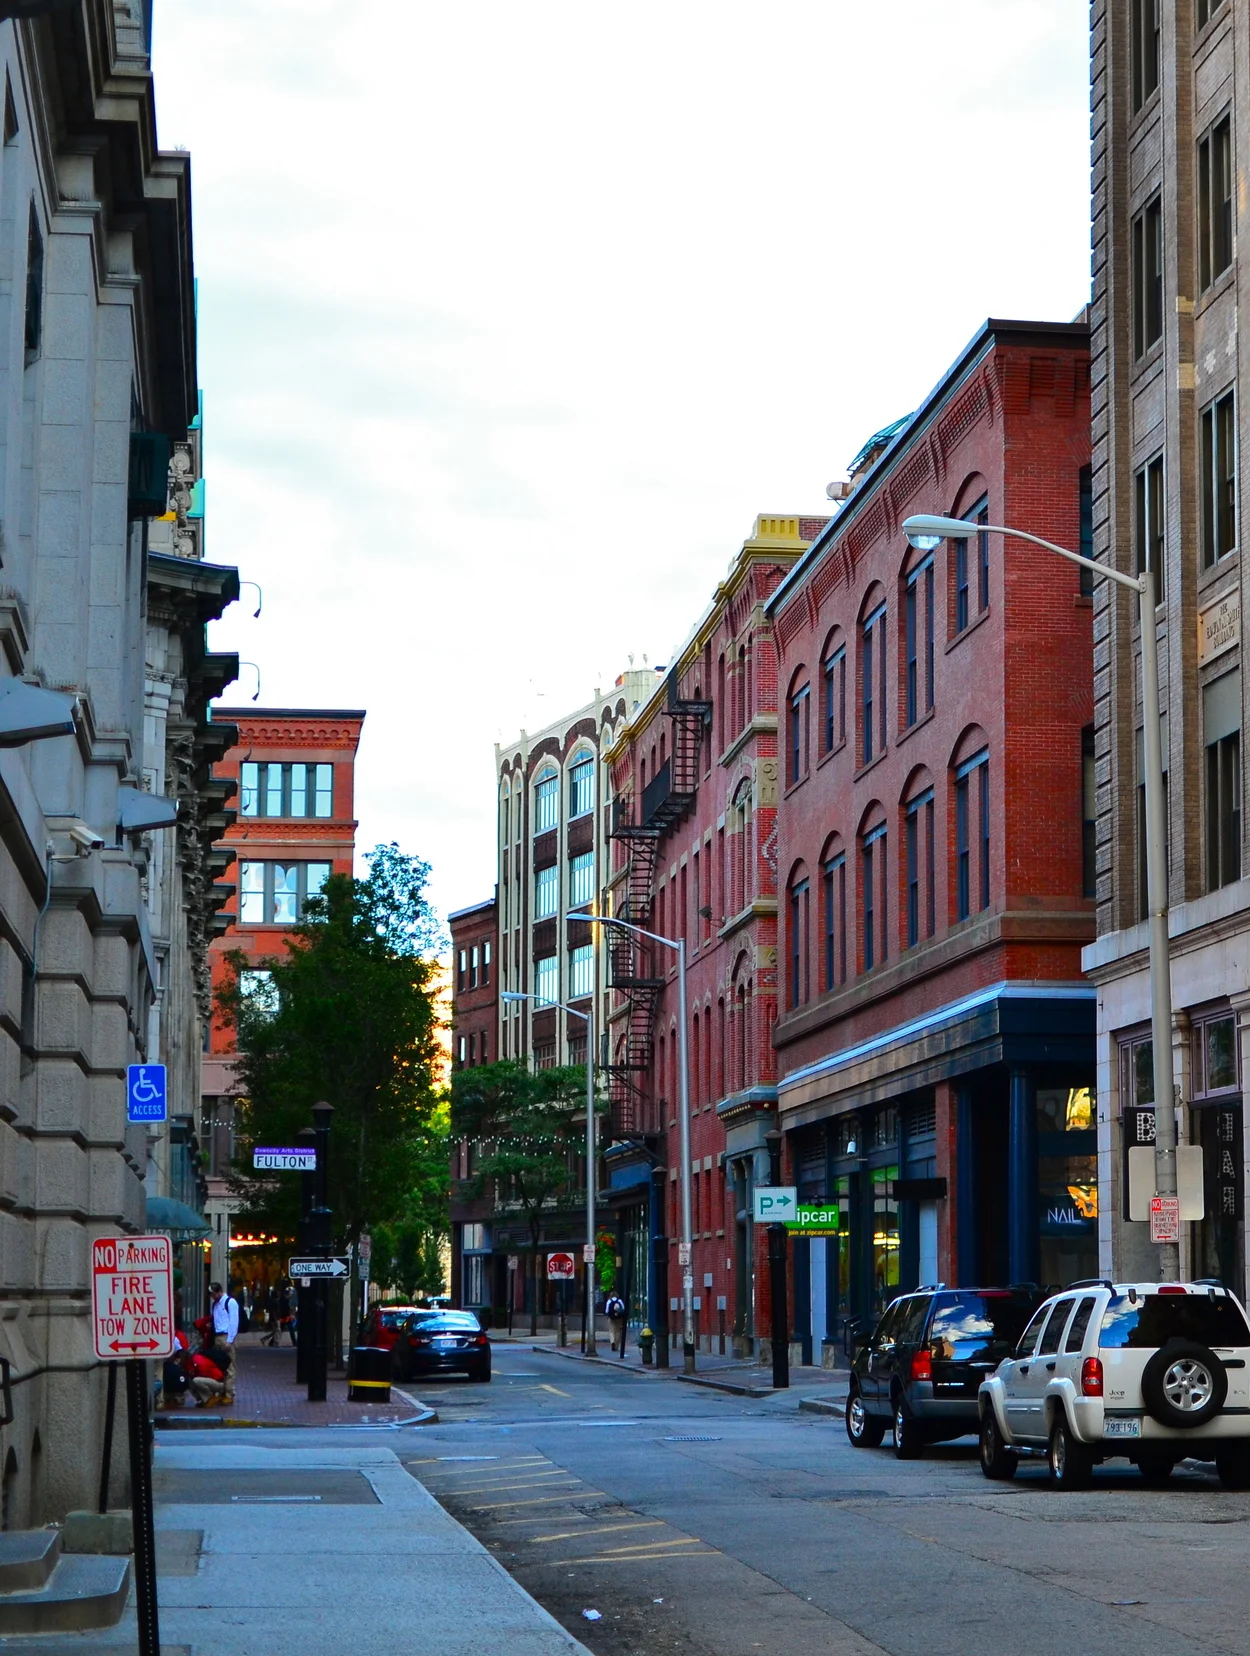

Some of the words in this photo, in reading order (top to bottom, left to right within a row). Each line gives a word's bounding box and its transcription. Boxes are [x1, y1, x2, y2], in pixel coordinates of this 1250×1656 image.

[133, 1105, 162, 1115] ACCESS
[256, 1155, 306, 1168] FULTON
[1152, 1200, 1161, 1209] NO
[796, 1208, 836, 1226] ipcar
[1047, 1207, 1082, 1224] NAIL
[95, 1246, 115, 1268] NO
[118, 1247, 166, 1264] PARKING
[295, 1263, 312, 1272] ONE
[315, 1263, 332, 1272] WAY
[111, 1276, 153, 1295] FIRE
[108, 1297, 157, 1316] LANE
[100, 1318, 126, 1336] TOW
[133, 1316, 168, 1335] ZONE
[1105, 1422, 1138, 1433] 793-196
